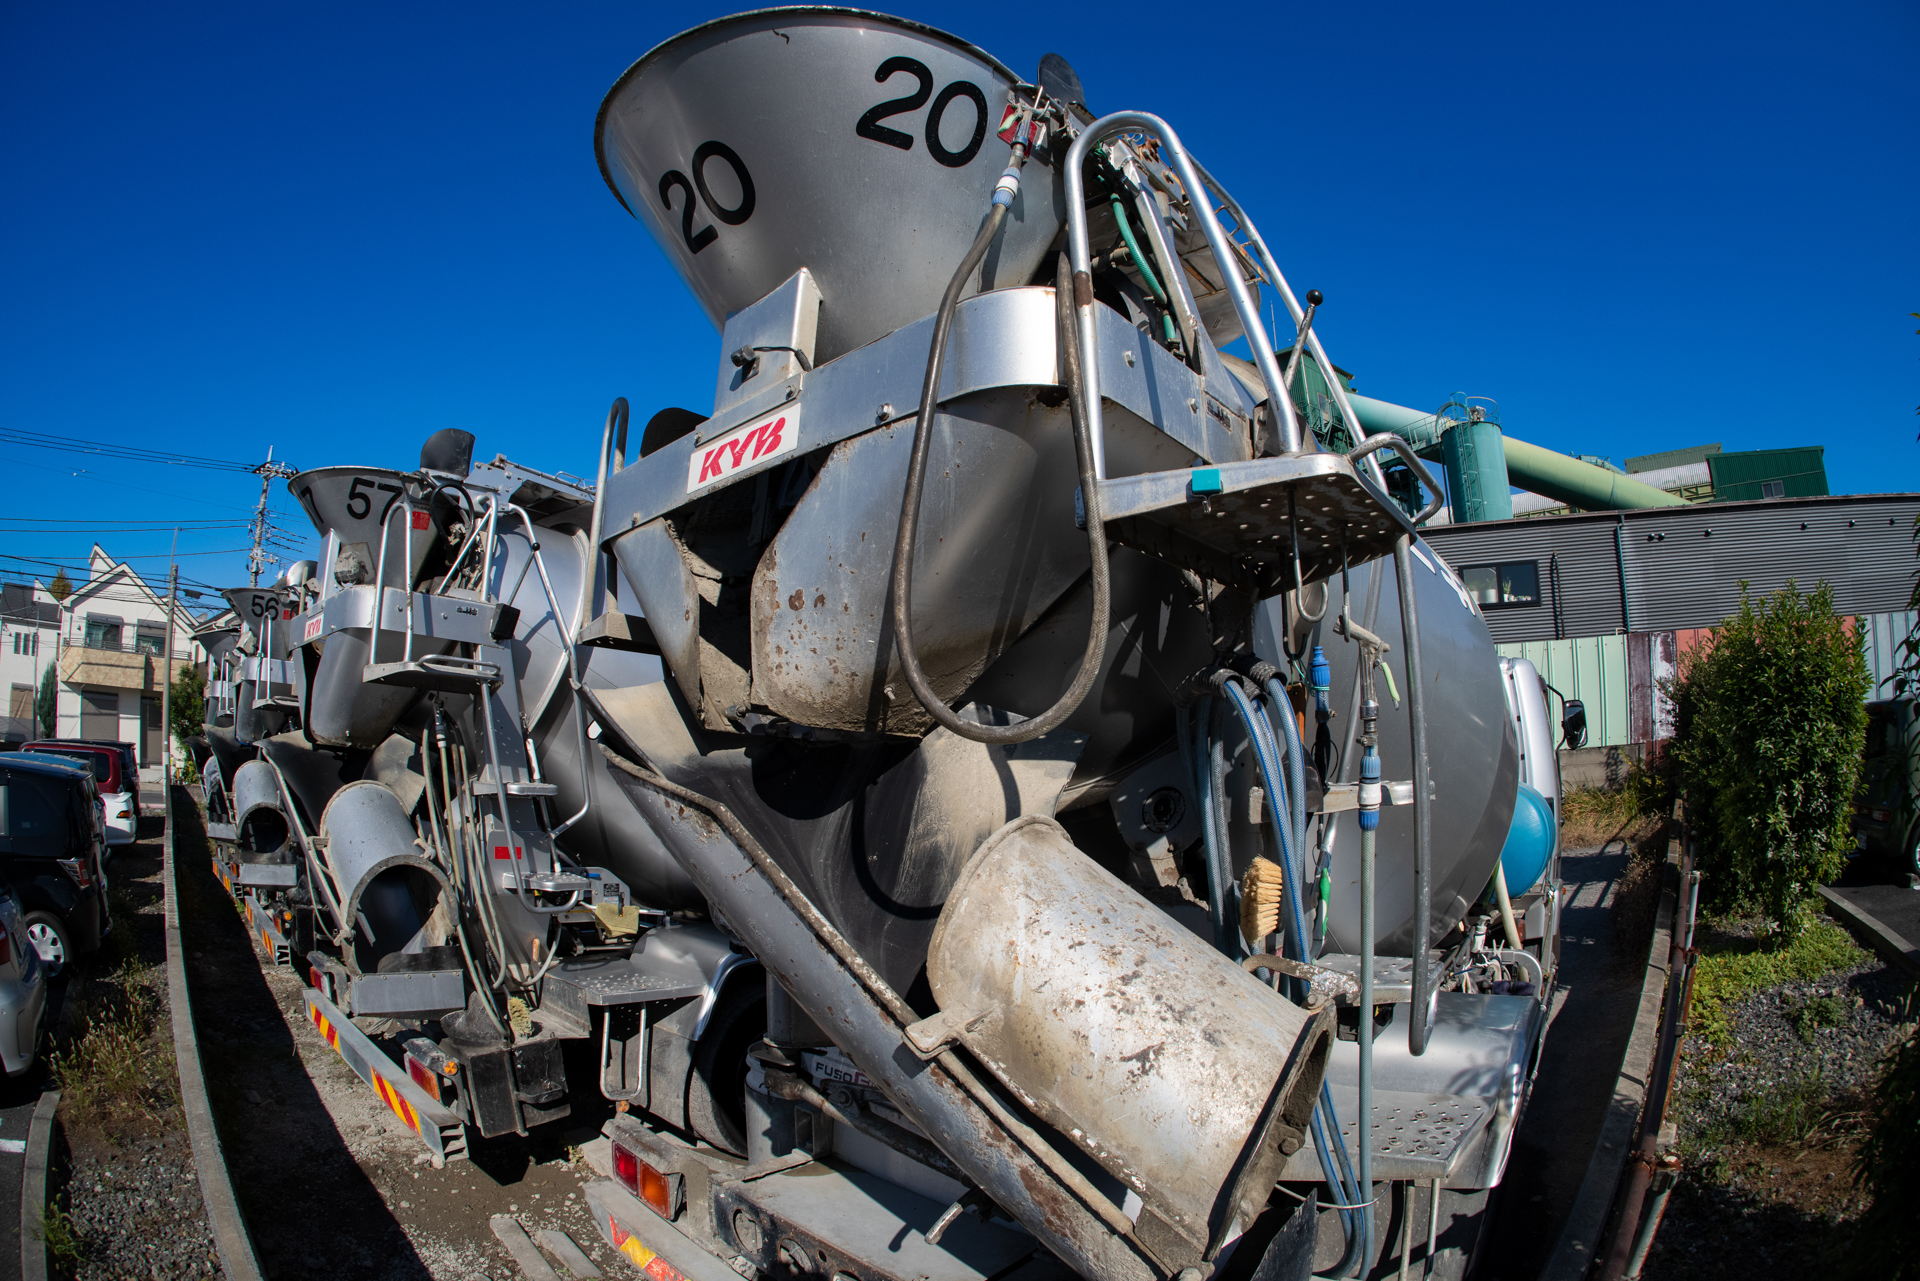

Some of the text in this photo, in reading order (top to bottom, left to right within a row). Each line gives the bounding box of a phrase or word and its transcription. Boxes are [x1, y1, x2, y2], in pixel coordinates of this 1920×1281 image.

[856, 56, 988, 168] 20
[658, 140, 756, 255] 20
[698, 416, 786, 483] KYB
[346, 477, 403, 526] 57
[251, 594, 279, 620] 56
[815, 1061, 853, 1084] FUSO
